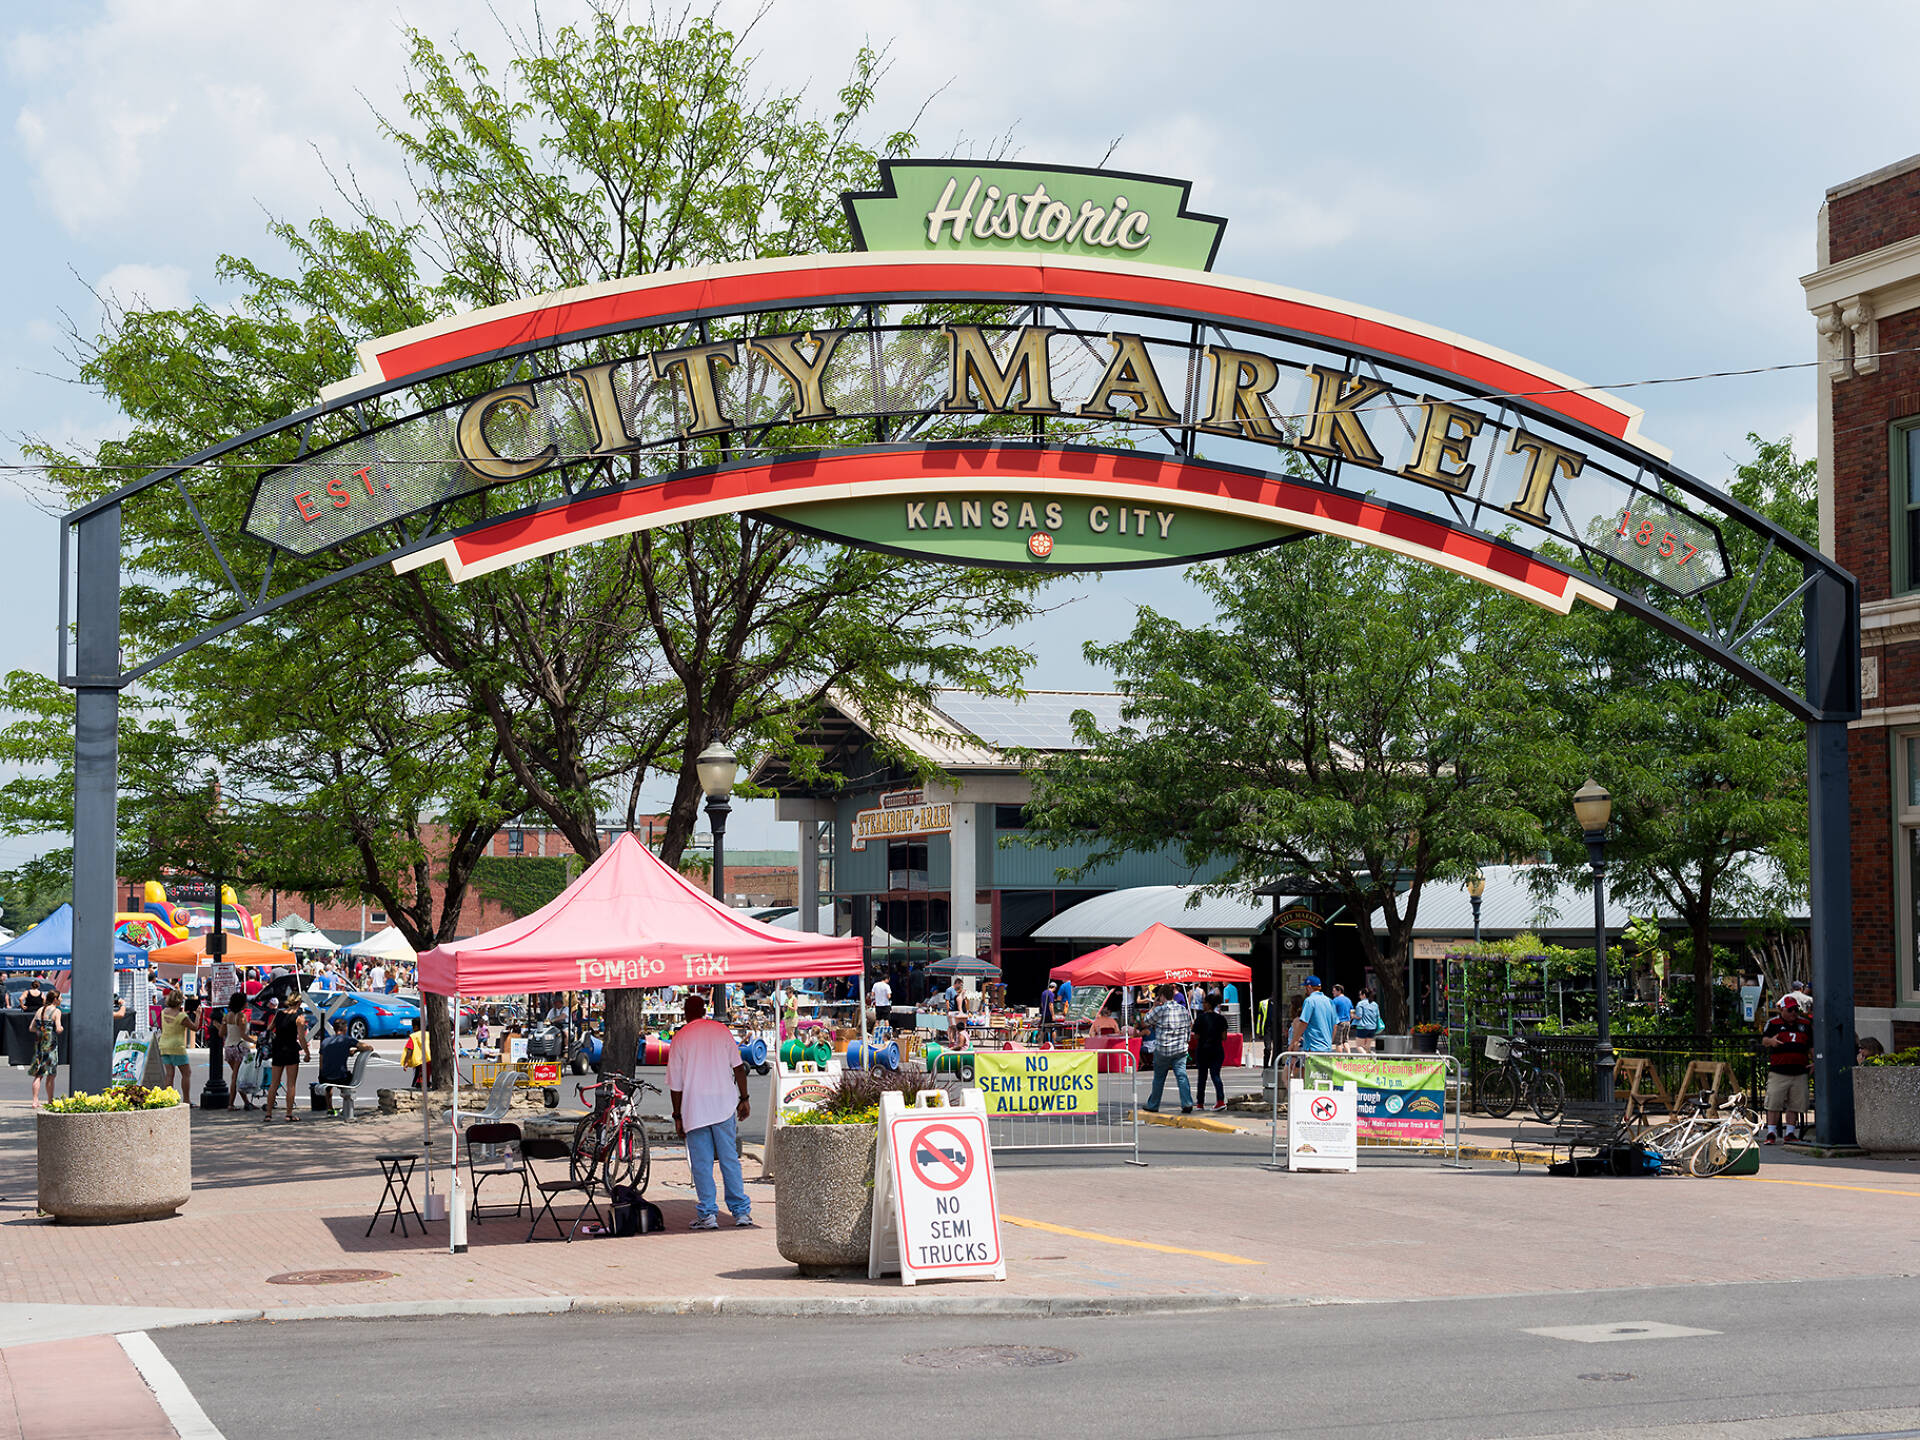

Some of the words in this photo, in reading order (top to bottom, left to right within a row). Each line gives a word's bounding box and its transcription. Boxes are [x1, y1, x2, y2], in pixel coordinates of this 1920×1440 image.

[927, 176, 1151, 250] Historic
[456, 328, 850, 482] CITY
[940, 324, 1588, 527] MARKET
[294, 466, 390, 522] EST.
[906, 501, 1064, 529] KANSAS
[1089, 506, 1175, 538] CITY
[1616, 511, 1698, 565] 1857
[858, 808, 914, 836] STEAMBOAT
[919, 804, 951, 829] ARABI
[18, 957, 55, 966] Ultimate
[1789, 1032, 1797, 1042] 7
[1026, 1056, 1048, 1072] NO
[1335, 1061, 1380, 1075] Wednesday
[1382, 1062, 1413, 1076] Evening
[1415, 1063, 1443, 1075] Market
[979, 1076, 1021, 1092] SEMI
[1027, 1074, 1094, 1091] TRUCKS
[790, 1088, 805, 1098] CITY
[997, 1095, 1077, 1112] ALLOWED
[936, 1196, 960, 1214] NO
[931, 1219, 971, 1239] SEMI
[919, 1243, 988, 1264] TRUCKS
